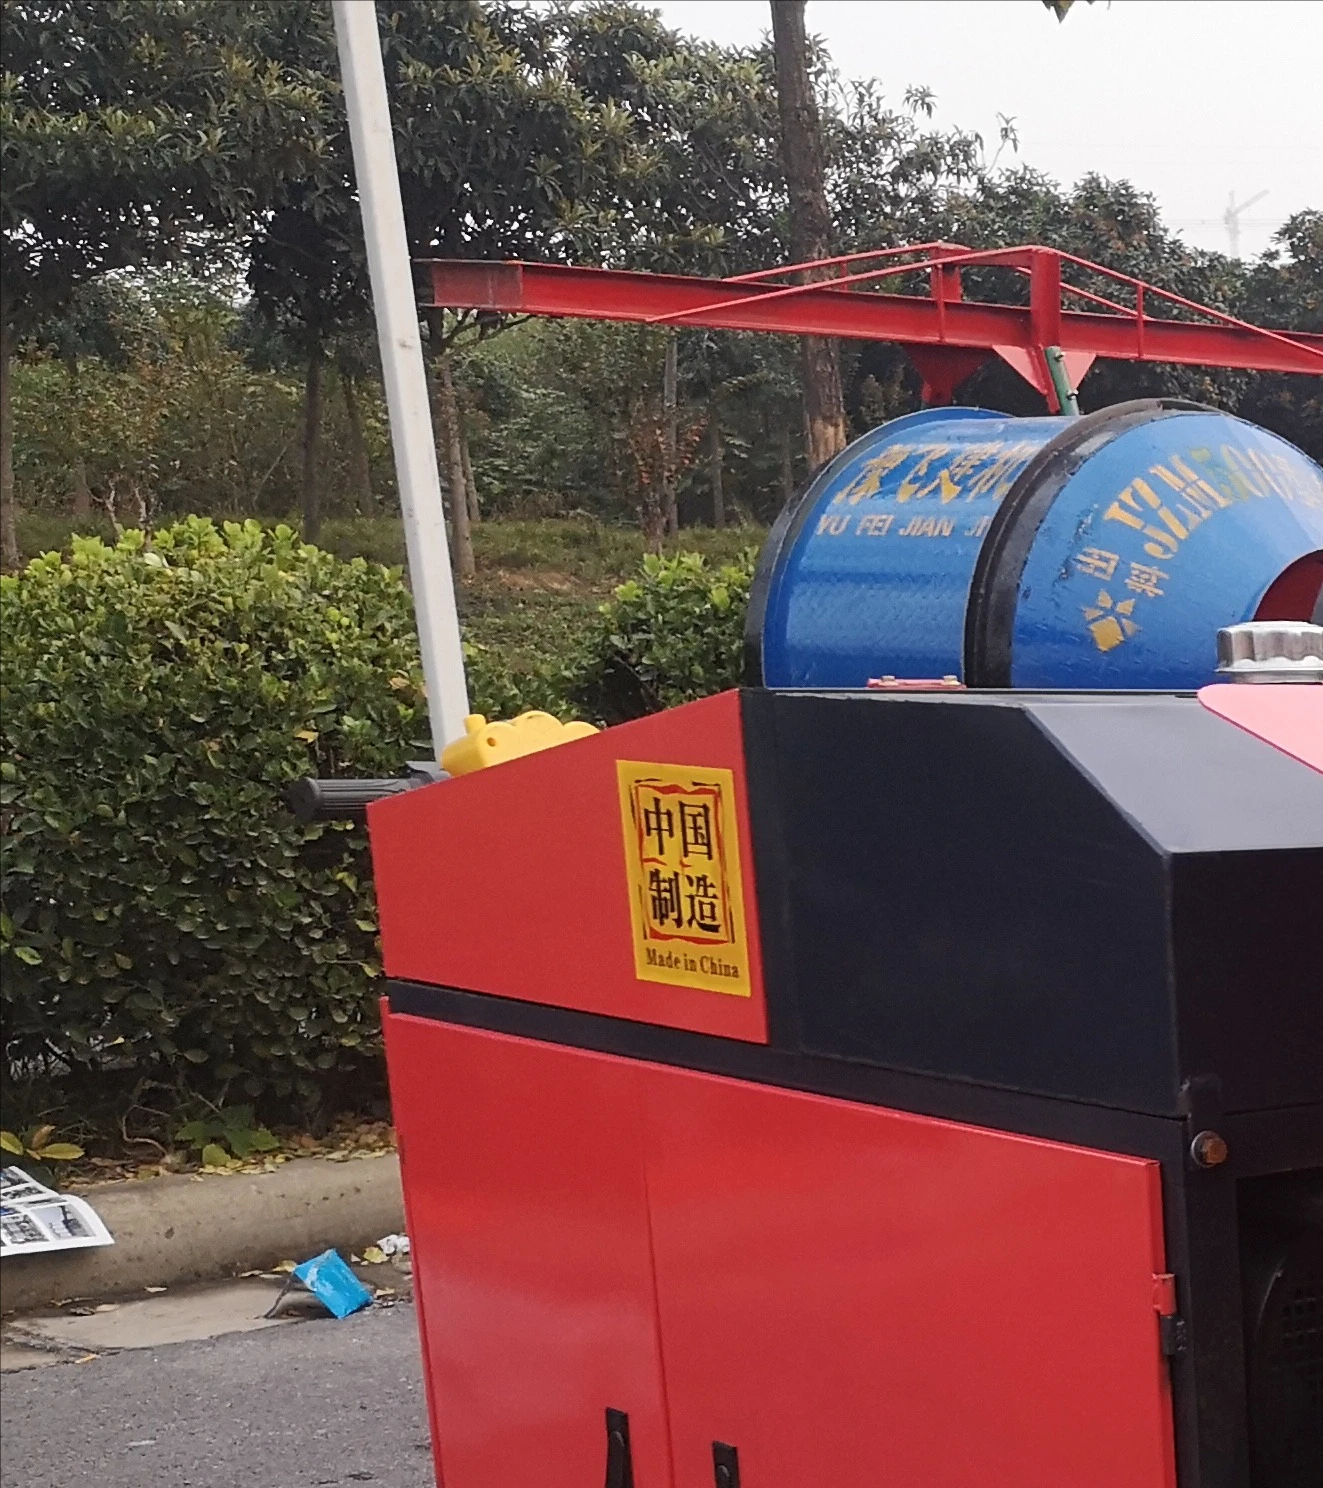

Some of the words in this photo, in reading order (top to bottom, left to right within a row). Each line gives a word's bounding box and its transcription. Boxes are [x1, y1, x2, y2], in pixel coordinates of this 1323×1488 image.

[815, 513, 851, 537] YU
[855, 513, 895, 537] FEI
[899, 514, 956, 538] JIAN
[643, 796, 714, 861] 中国
[648, 867, 722, 934] 制造
[645, 947, 681, 971] Made
[683, 953, 698, 973] in
[699, 956, 740, 979] China
